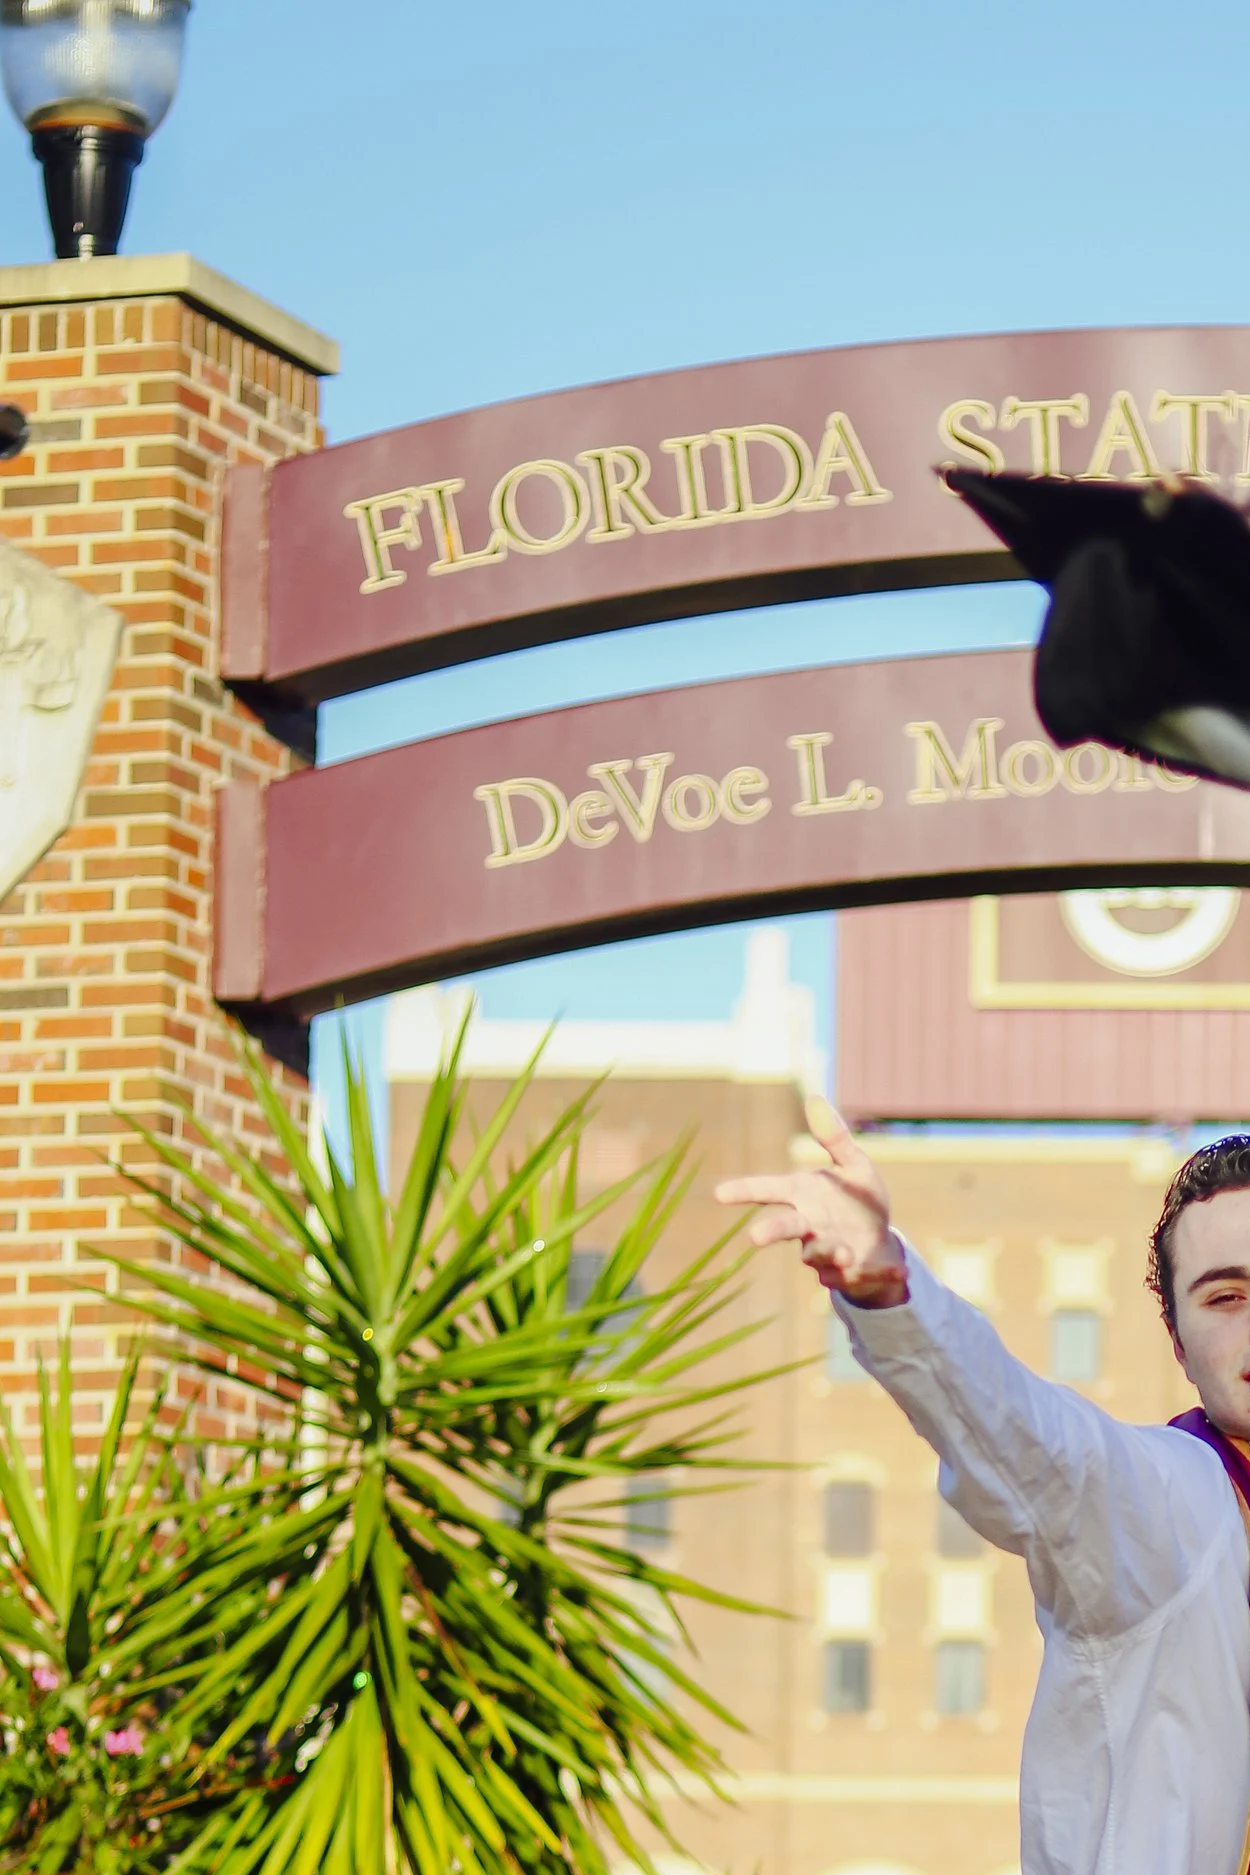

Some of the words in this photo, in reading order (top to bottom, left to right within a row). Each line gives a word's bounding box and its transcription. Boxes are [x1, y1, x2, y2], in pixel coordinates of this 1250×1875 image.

[342, 411, 893, 596] FLORIDA
[473, 750, 771, 870] DeVoe
[787, 731, 884, 816] L.
